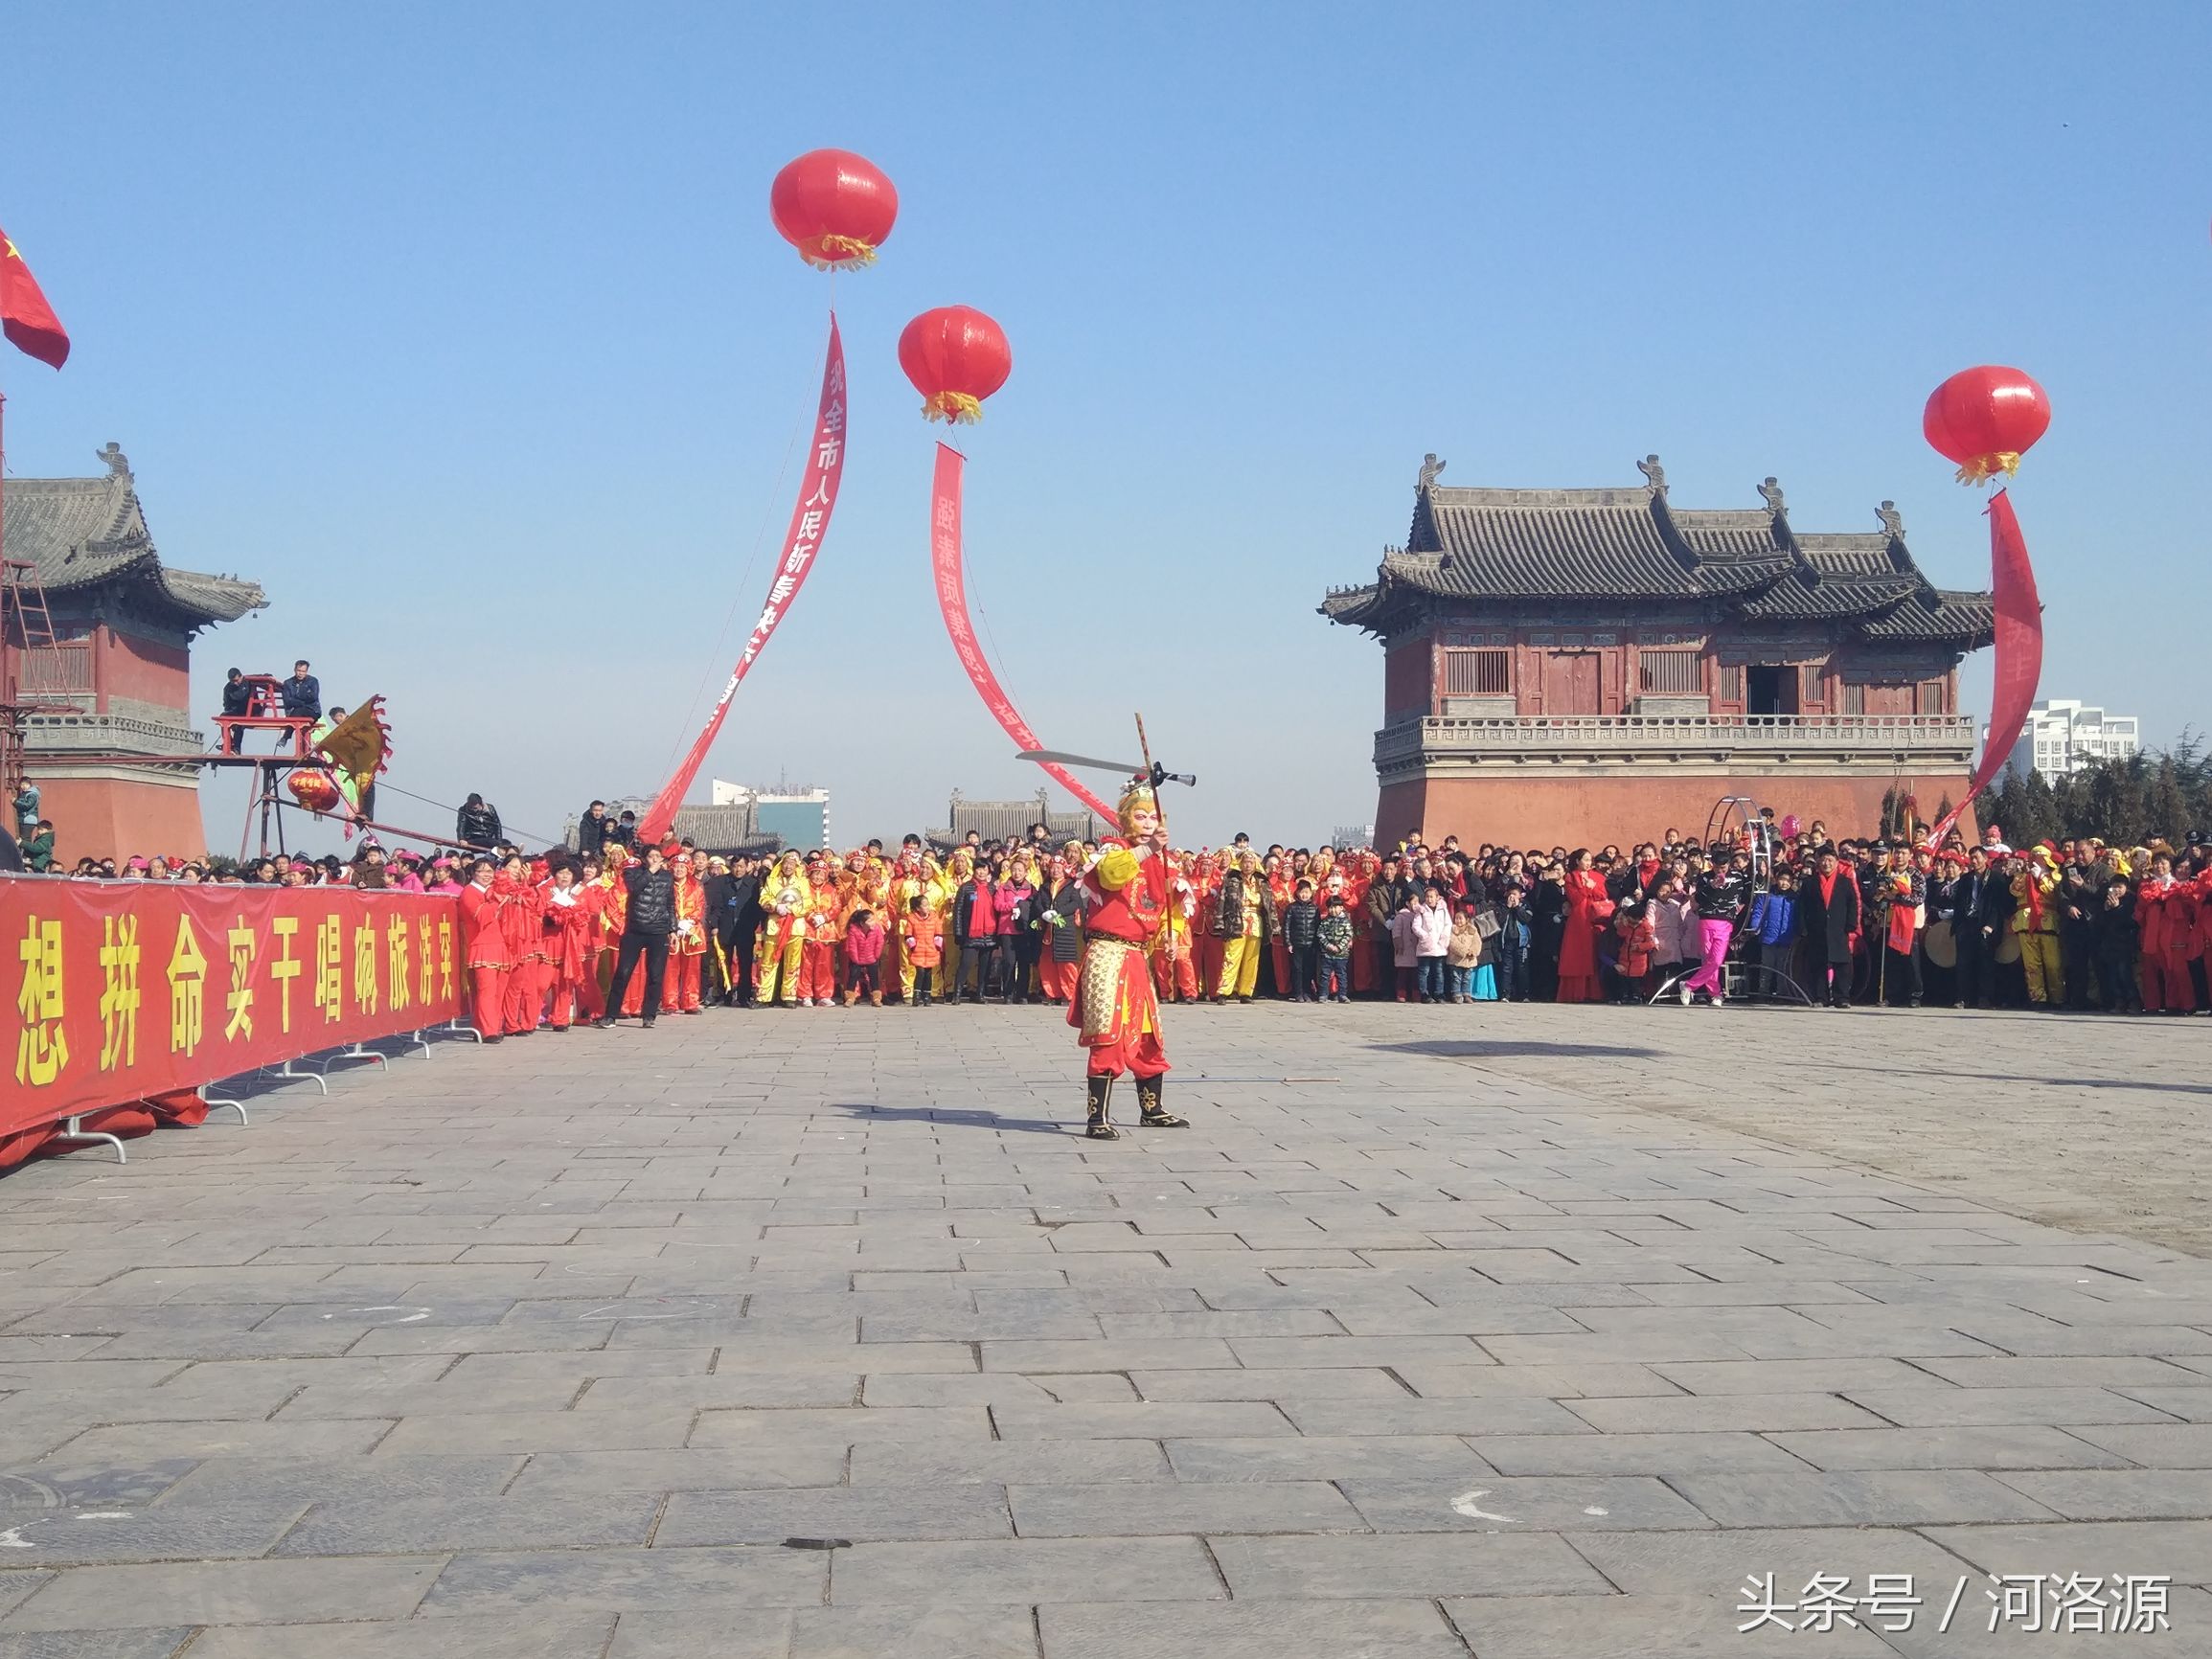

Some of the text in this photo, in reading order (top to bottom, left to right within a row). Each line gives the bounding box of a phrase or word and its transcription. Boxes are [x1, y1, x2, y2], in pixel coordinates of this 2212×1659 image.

[14, 912, 452, 1086] 想拼命实干唱响旅游突
